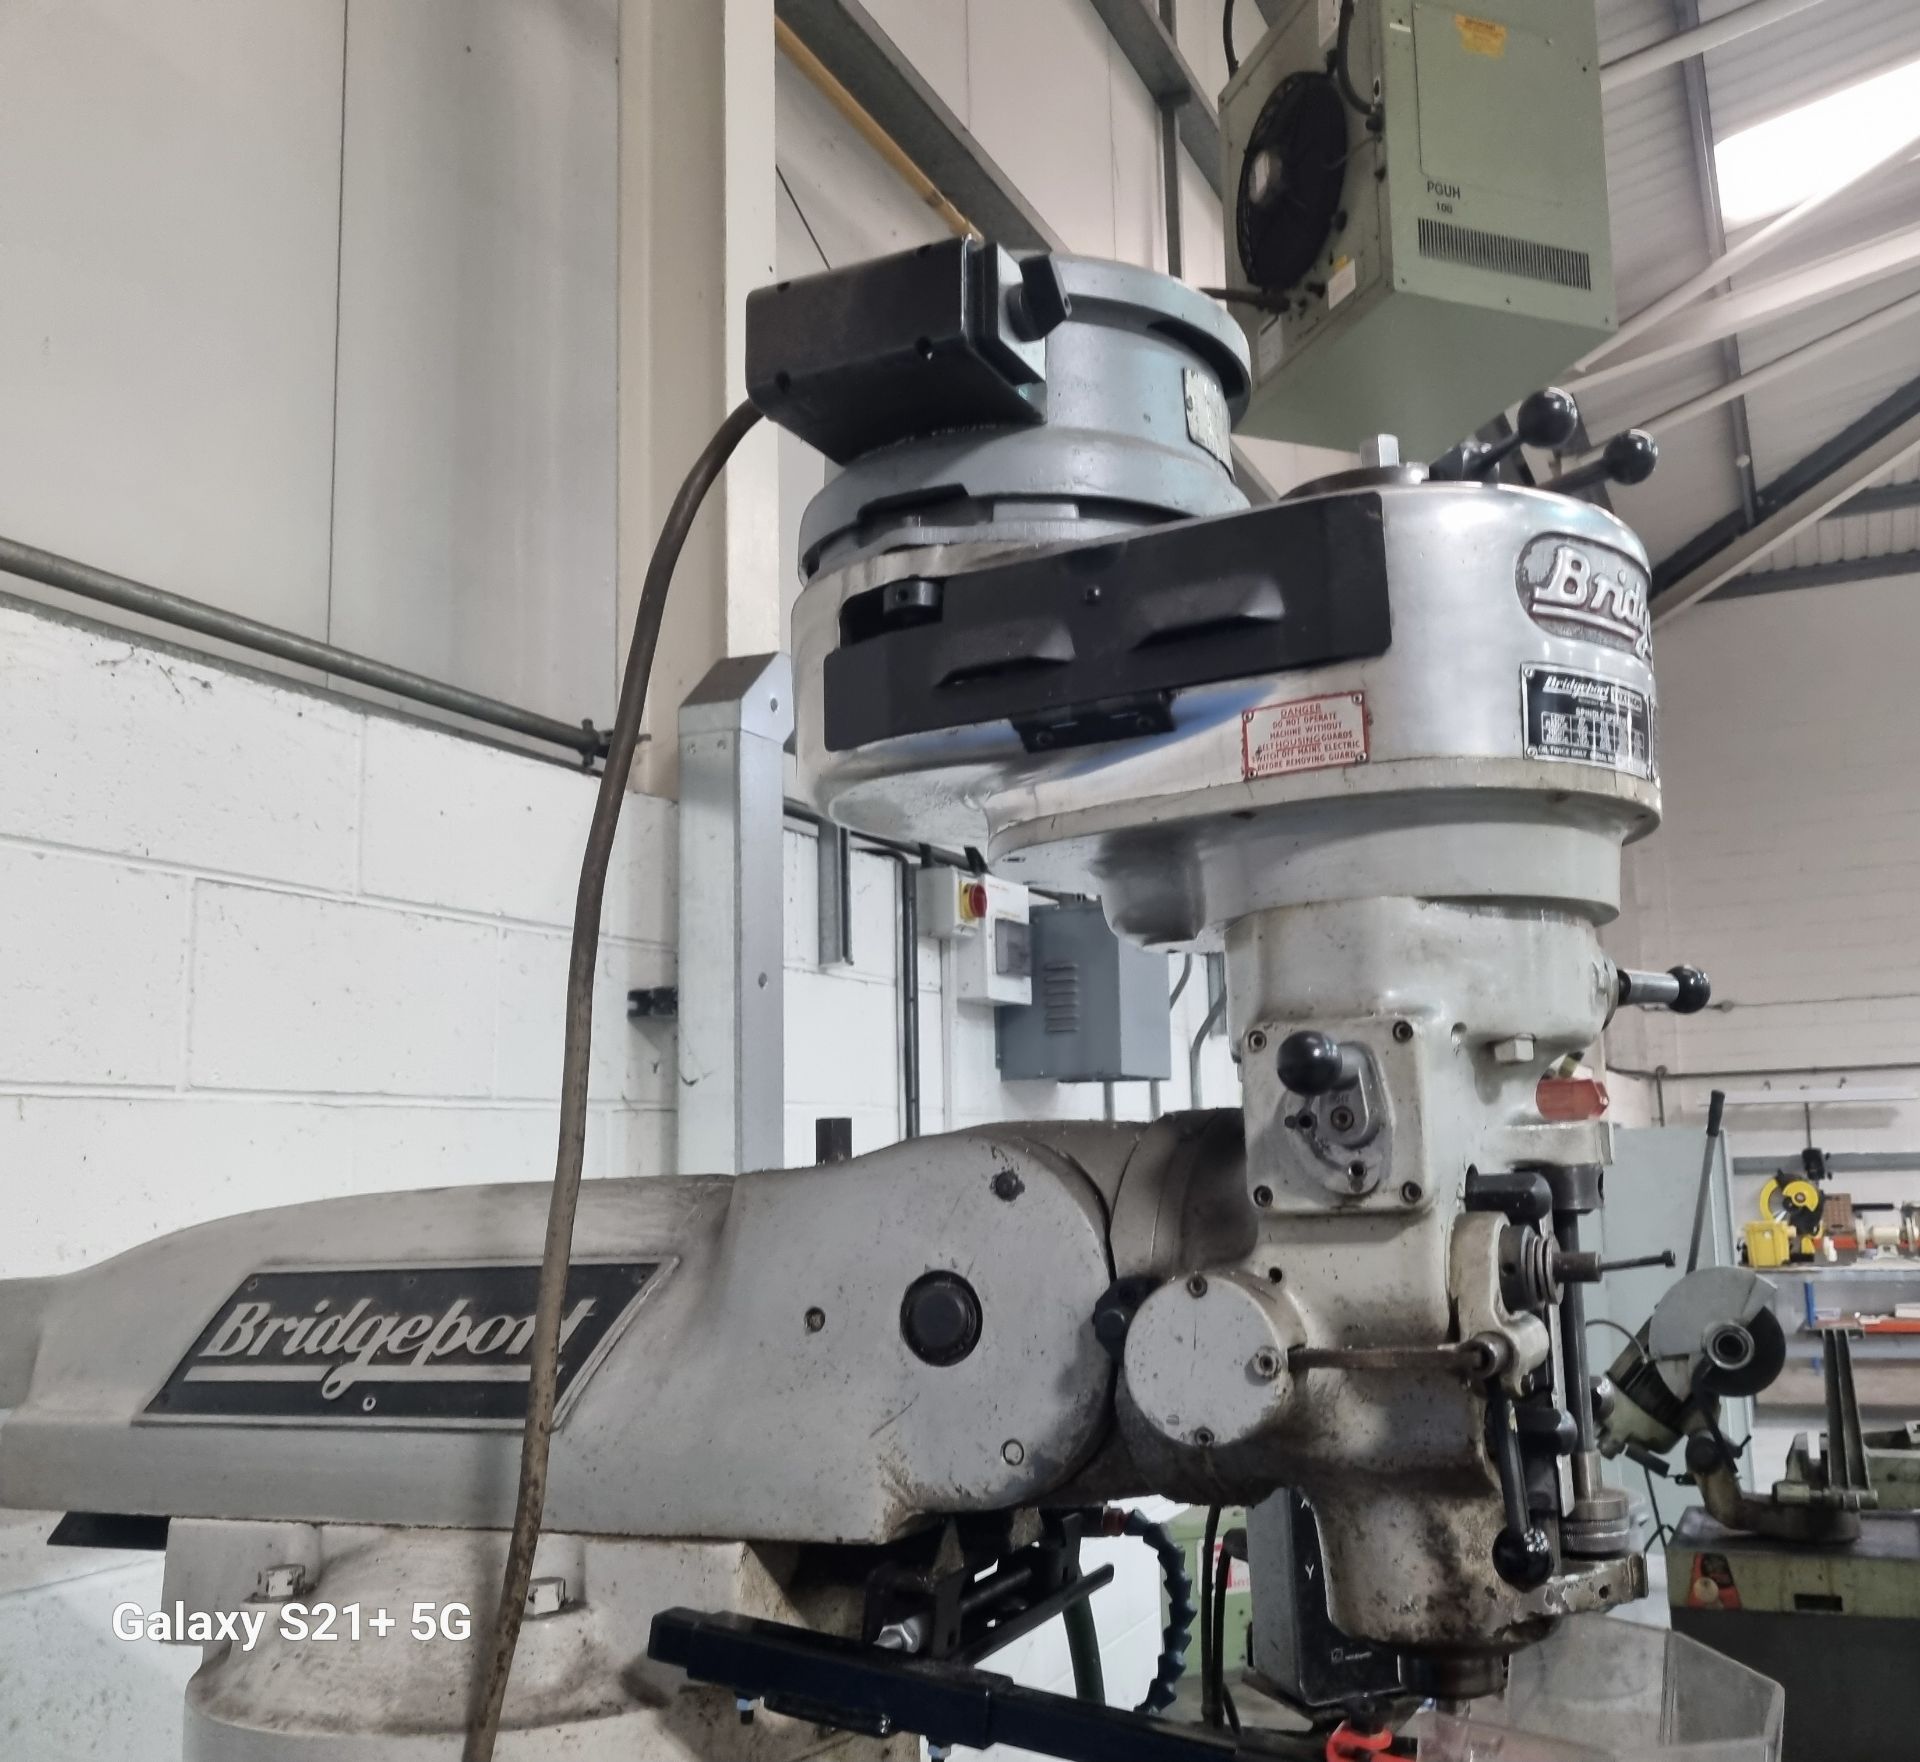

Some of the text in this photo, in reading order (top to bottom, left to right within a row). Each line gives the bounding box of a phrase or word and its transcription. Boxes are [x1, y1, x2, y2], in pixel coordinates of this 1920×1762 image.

[1280, 703, 1322, 718] DANGER
[1272, 712, 1337, 729] DO NOT OPERATE
[1269, 721, 1343, 740] MACHINE WITHOUT
[1275, 735, 1321, 750] HOUSING
[1321, 730, 1353, 742] GUARDS
[1281, 749, 1295, 759] OFF
[1297, 744, 1321, 756] MAINS
[1324, 740, 1361, 753] ELECTRIC
[1257, 760, 1283, 771] BEFORE
[1285, 755, 1325, 767] REMOVING
[199, 1298, 598, 1400] Bridgeport
